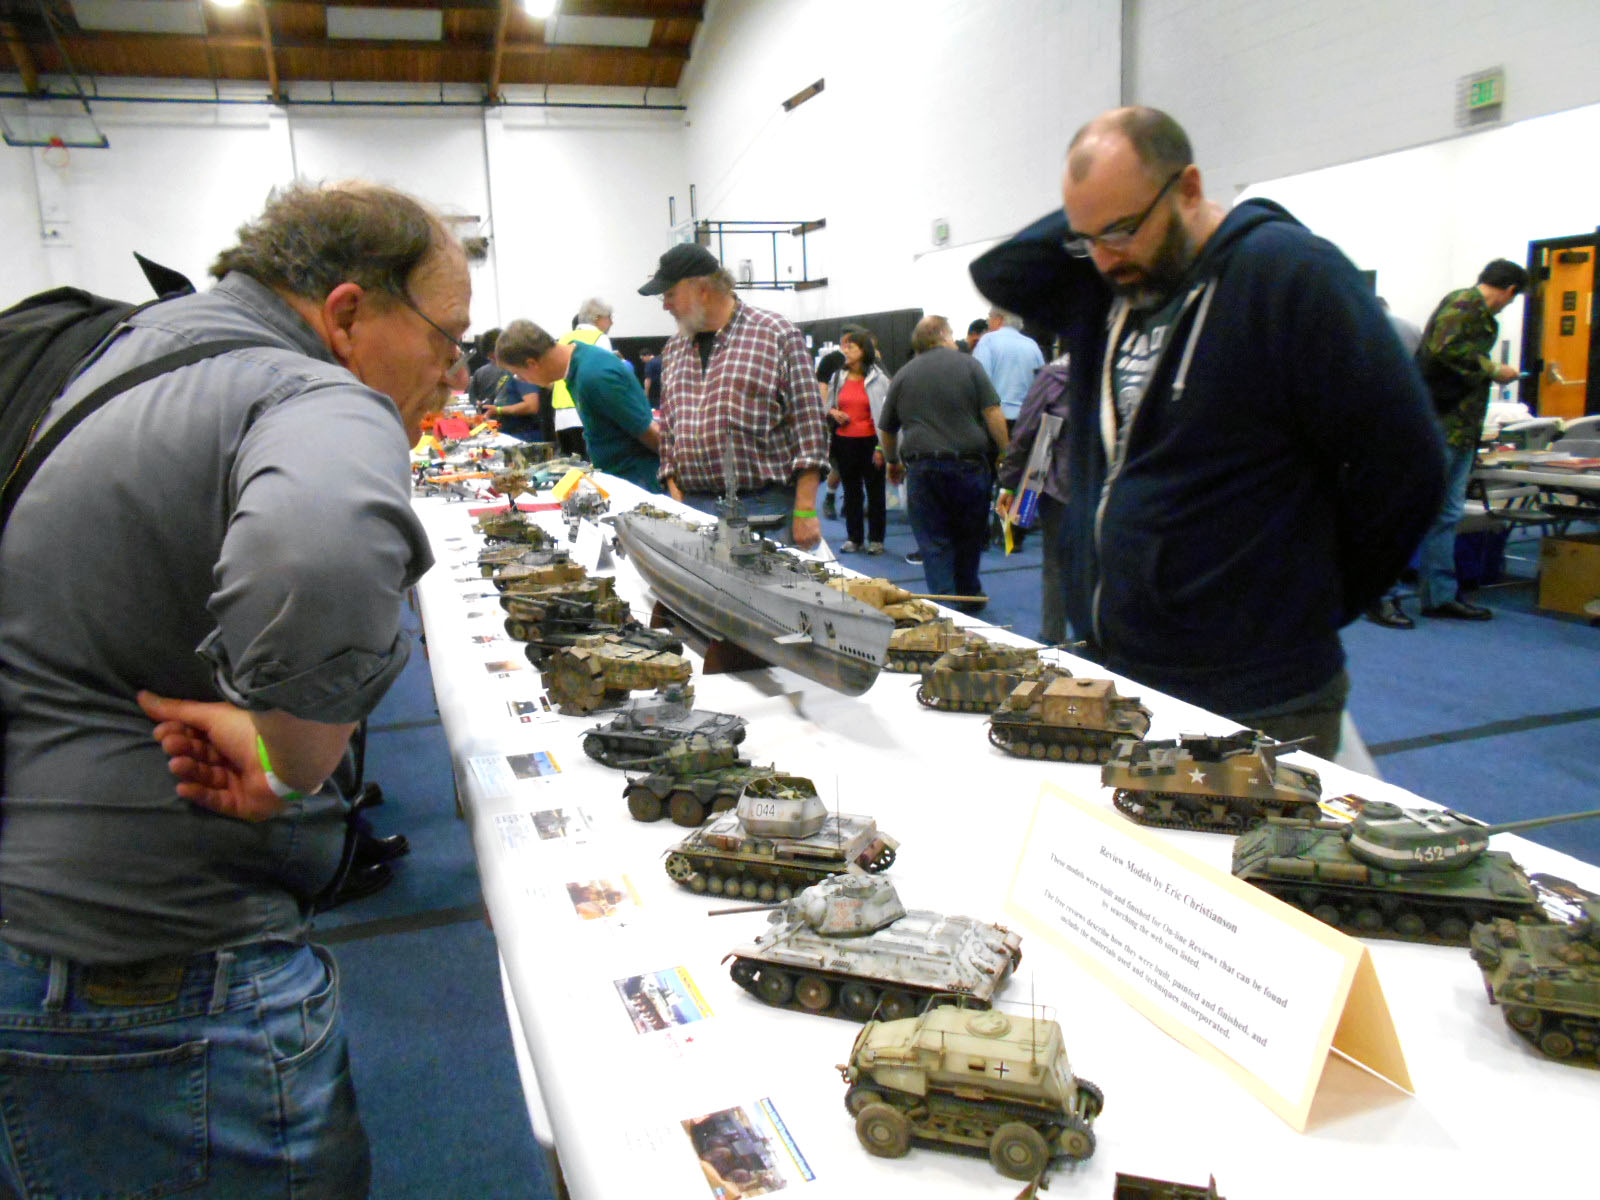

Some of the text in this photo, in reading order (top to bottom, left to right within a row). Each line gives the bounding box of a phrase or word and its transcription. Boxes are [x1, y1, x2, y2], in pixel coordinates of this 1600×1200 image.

[756, 803, 775, 817] 044
[1066, 864, 1085, 879] models
[1086, 876, 1099, 888] were
[1114, 894, 1126, 906] and
[1126, 900, 1151, 921] finished
[1151, 916, 1162, 928] for
[1163, 923, 1187, 945] On-line
[1188, 939, 1218, 964] Reviews
[1219, 959, 1235, 975] that
[1236, 971, 1251, 985] can
[1252, 979, 1262, 992] be
[1263, 986, 1288, 1008] found
[1099, 845, 1238, 934] Review Models by Eric Christianson
[1110, 906, 1139, 930] searching
[1139, 924, 1150, 936] the
[1150, 932, 1163, 945] web
[1164, 942, 1179, 955] sites
[1180, 949, 1200, 970] listed.
[1080, 927, 1089, 939] the
[1089, 935, 1117, 959] materials
[1117, 955, 1132, 969] used
[1132, 965, 1144, 978] and
[1145, 974, 1180, 1003] techniques
[1180, 1000, 1231, 1040] incorporated.
[1086, 918, 1110, 939] describe
[1110, 934, 1123, 948] how
[1124, 944, 1137, 958] they
[1138, 955, 1153, 969] were
[1172, 978, 1201, 1001] painted
[1201, 998, 1217, 1012] and
[1217, 1006, 1250, 1036] finished,
[1251, 1032, 1268, 1047] and
